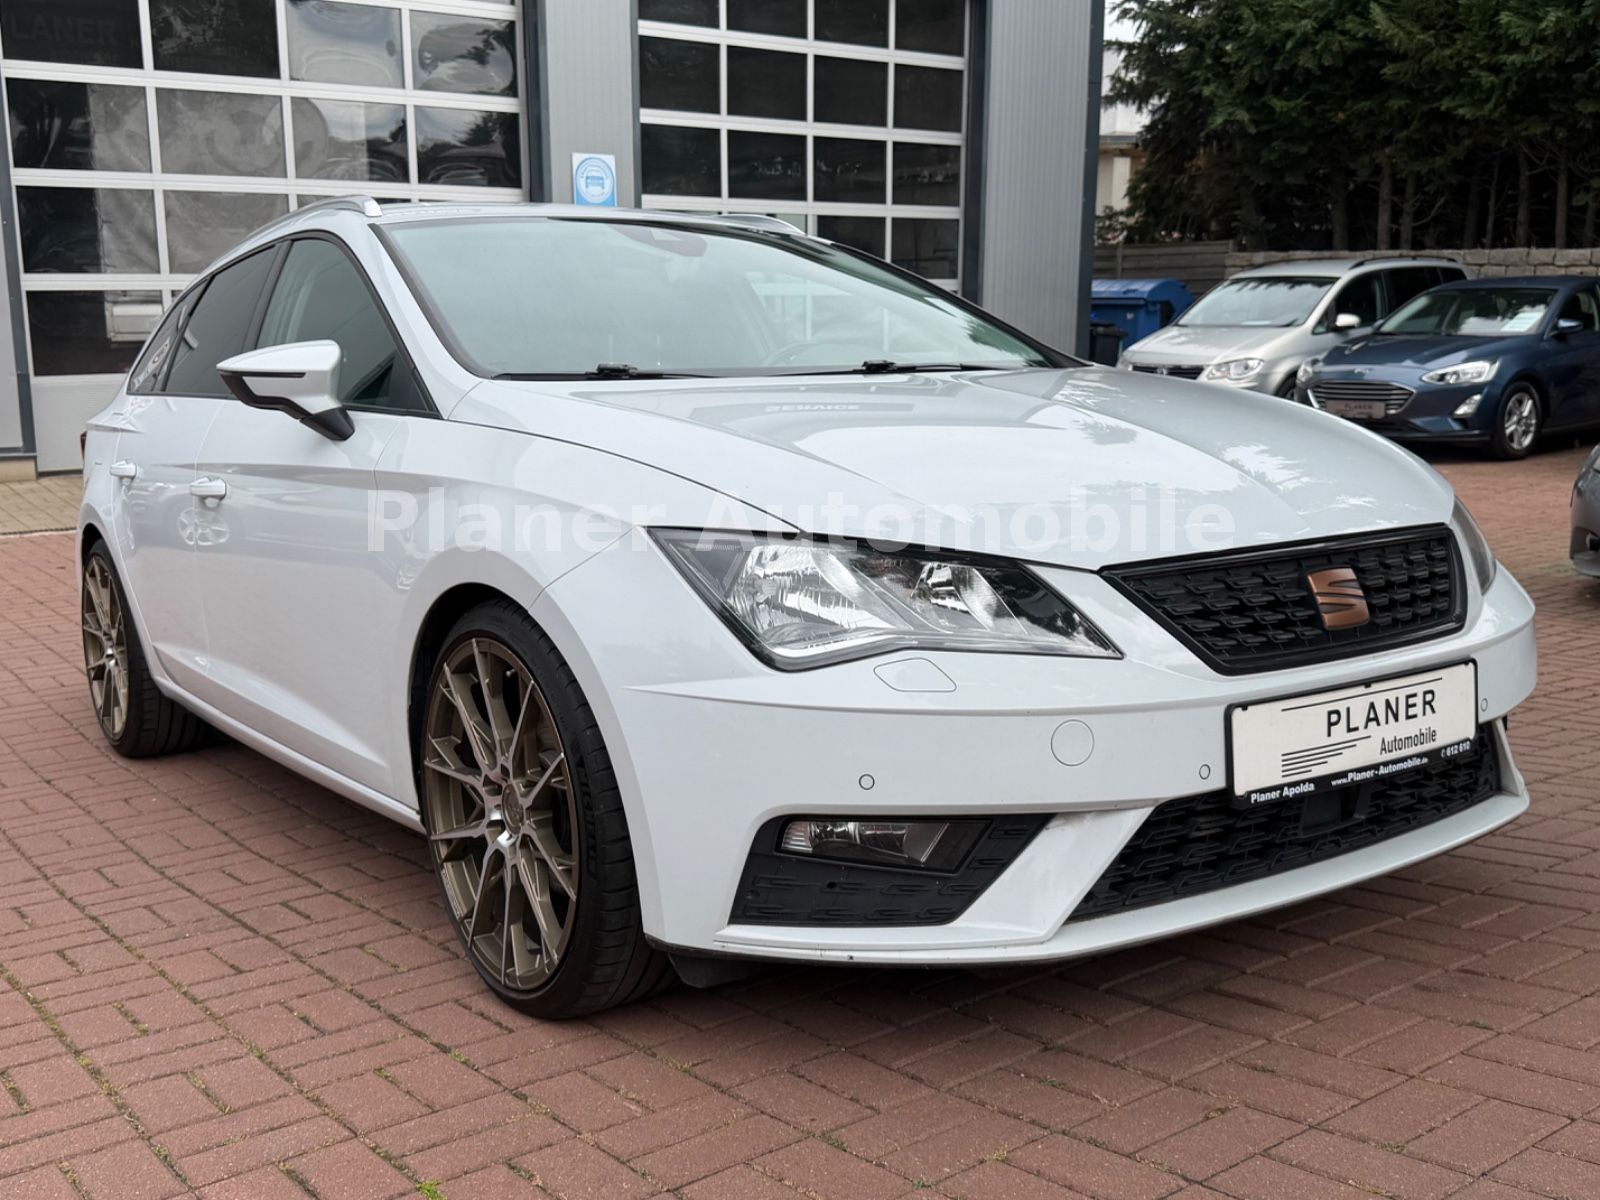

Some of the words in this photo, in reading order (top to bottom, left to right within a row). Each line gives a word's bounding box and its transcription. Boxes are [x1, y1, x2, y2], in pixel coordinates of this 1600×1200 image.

[1327, 689, 1437, 737] PLANER
[1379, 727, 1437, 755] Automobile
[1331, 756, 1429, 786] www.Planer-Automobile.de
[1250, 789, 1281, 804] Planer
[1282, 782, 1315, 798] Apolda
